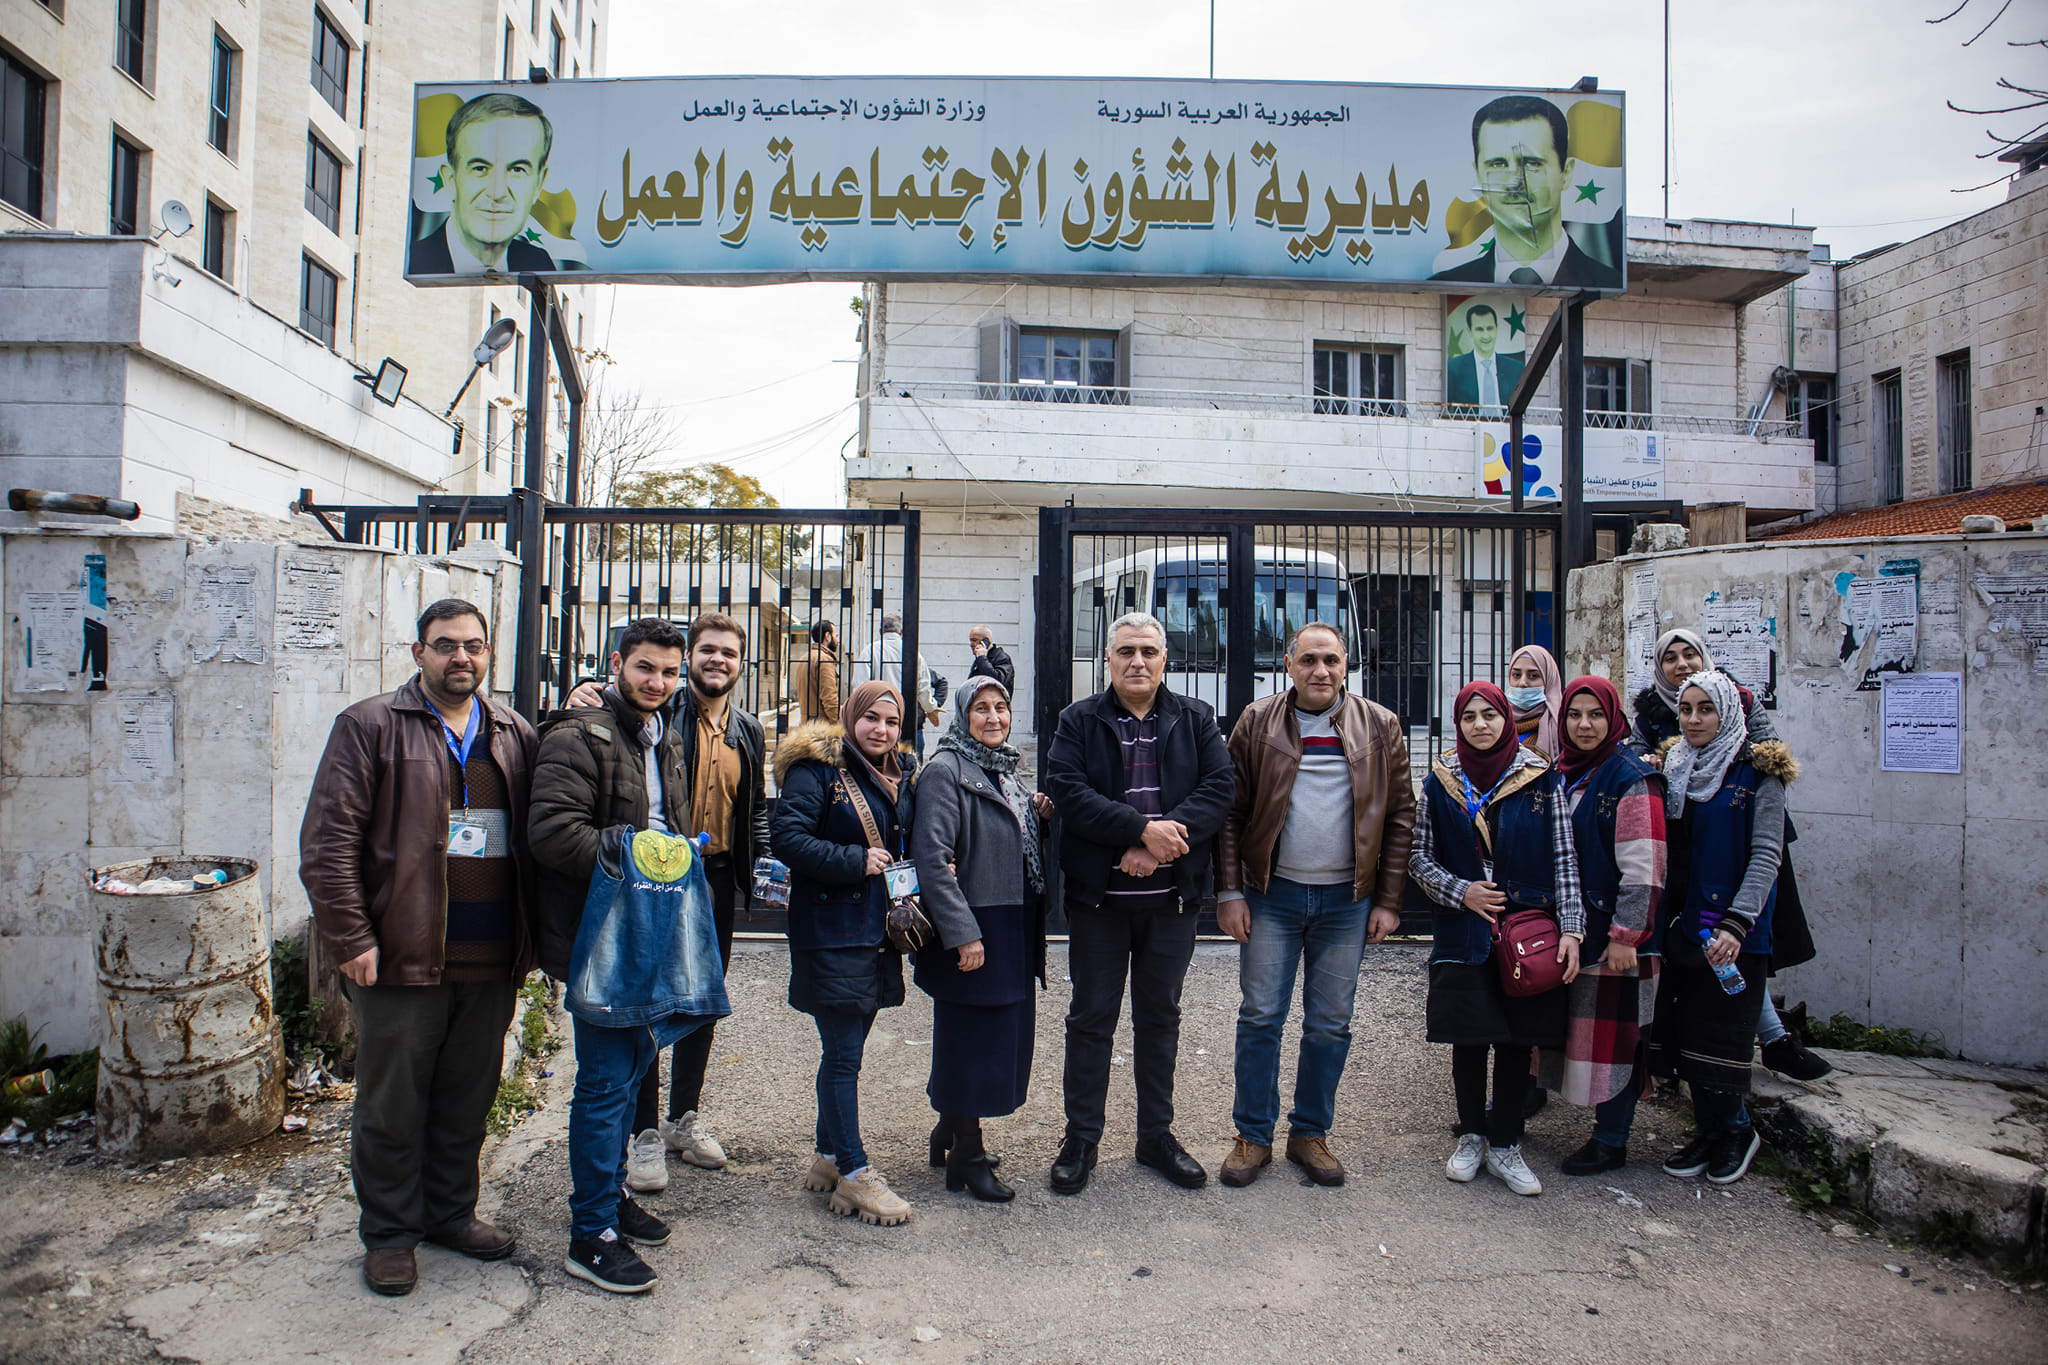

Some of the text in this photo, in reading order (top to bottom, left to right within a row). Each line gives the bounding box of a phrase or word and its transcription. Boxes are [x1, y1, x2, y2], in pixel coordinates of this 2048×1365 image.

[682, 97, 986, 123] وزارة الشؤون الإجتماعية والعمل
[1097, 101, 1351, 127] الجمهورية العربية السورية
[596, 136, 1431, 265] مديرية الشؤون الإجتماعية والعمل
[1596, 489, 1636, 497] Empowerment
[1608, 478, 1630, 487] تمكين
[1632, 478, 1658, 489] مشروع
[863, 811, 880, 842] LOUIS
